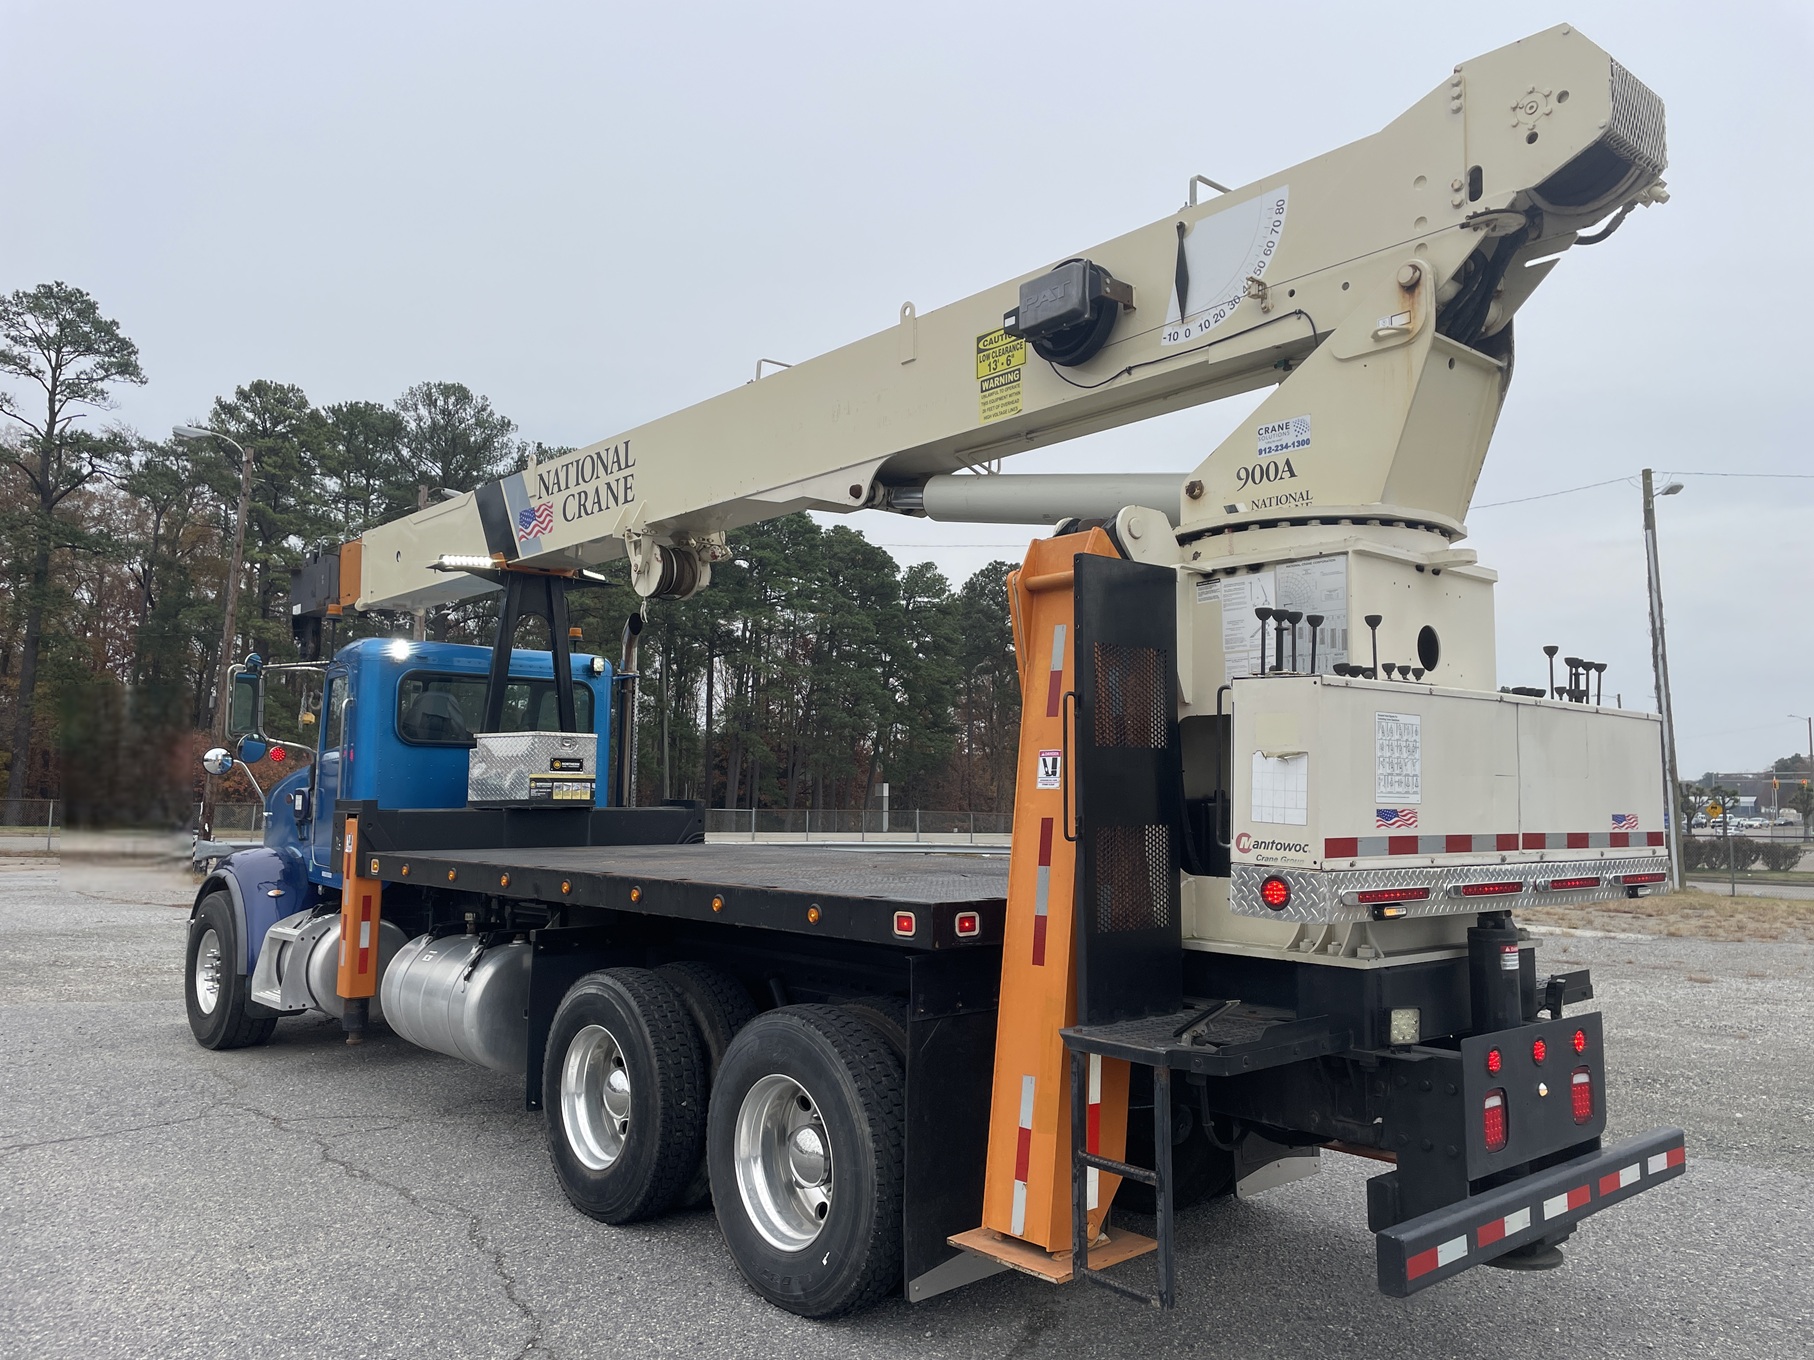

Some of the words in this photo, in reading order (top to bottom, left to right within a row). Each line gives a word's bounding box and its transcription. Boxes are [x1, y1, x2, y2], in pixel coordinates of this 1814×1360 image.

[1274, 199, 1285, 215] 80
[1270, 219, 1282, 235] 70
[1263, 240, 1275, 256] 60
[1253, 260, 1266, 276] 50
[1021, 280, 1071, 314] PAT
[1227, 295, 1241, 310] 30
[1212, 308, 1226, 324] 20
[1184, 328, 1191, 338] 0
[1198, 319, 1211, 332] 10
[982, 333, 1012, 348] CAUTIO
[1162, 330, 1179, 342] -10
[979, 352, 991, 363] LOW
[991, 341, 1024, 359] CLEARANCE
[981, 370, 1020, 391] WARNING
[1257, 421, 1290, 436] CRANE
[1258, 430, 1290, 442] SOLUTIONS
[1258, 438, 1311, 456] 912-234-1300
[537, 439, 637, 500] NATIONAL
[1236, 457, 1298, 492] 900A
[562, 473, 636, 523] CRANE
[1251, 489, 1314, 511] NATIONAL
[1238, 835, 1309, 853] Manitowoc
[1255, 854, 1278, 862] Crane
